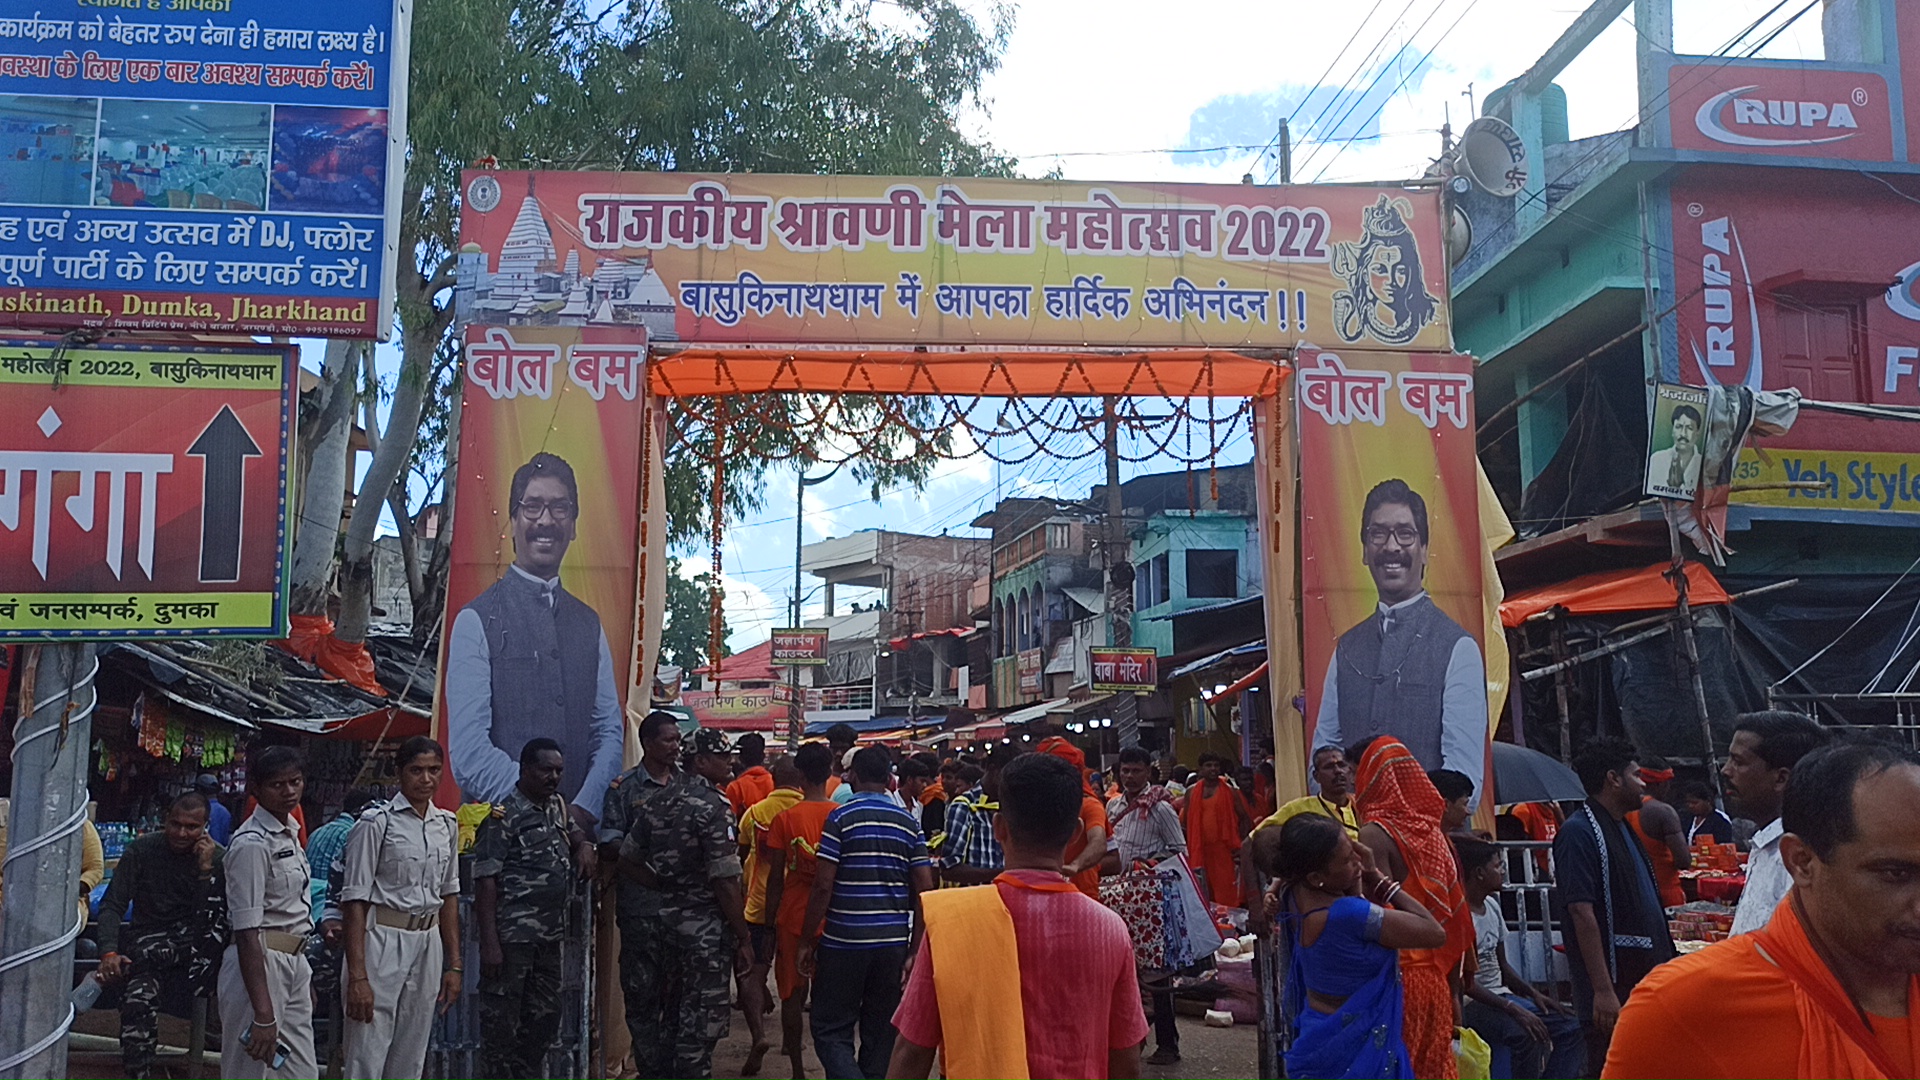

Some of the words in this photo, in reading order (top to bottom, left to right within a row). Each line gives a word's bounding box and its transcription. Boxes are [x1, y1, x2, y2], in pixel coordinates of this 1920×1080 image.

[0, 11, 74, 43] कार्यक्रम
[78, 15, 104, 42] को
[108, 15, 162, 45] बेहतर
[200, 19, 234, 47] देना
[238, 19, 260, 48] ही
[263, 29, 313, 50] हमारा
[317, 31, 359, 52] लक्ष्य
[0, 54, 53, 78] वस्था
[55, 50, 79, 79] के
[82, 50, 120, 82] लिए
[126, 59, 162, 82] एक
[165, 61, 199, 84] बार
[201, 63, 262, 87] अवश्य
[265, 59, 330, 89] सम्पर्क
[1732, 97, 1859, 129] RUPA
[26, 210, 71, 243] एवं
[74, 219, 138, 244] अन्य
[144, 220, 221, 246] उत्सव
[227, 216, 257, 248] में
[259, 222, 296, 252] DJ,
[303, 222, 374, 252] फ्लोर
[580, 183, 771, 248] राजकीय
[774, 186, 928, 250] श्रावणी
[939, 188, 1036, 253] मेला
[1043, 190, 1218, 256] महोत्सव
[1224, 207, 1331, 262] 2022
[52, 249, 110, 281] पार्टी
[115, 252, 147, 282] के
[154, 251, 209, 284] लिए
[215, 255, 305, 287] सम्पर्क
[122, 295, 221, 321] Dumka,
[227, 297, 367, 324] Jharkhand
[680, 271, 885, 326] बासुकिनाथधाम
[896, 274, 924, 318] में
[935, 284, 1033, 319] आपका
[1044, 276, 1131, 321] हार्दिक
[1701, 216, 1735, 366] RUPA
[80, 360, 141, 380] 2022,
[149, 357, 277, 383] बासुकिनाथधाम
[466, 329, 561, 399] बोल
[569, 344, 645, 399] बम
[1299, 354, 1391, 424] बोल
[1400, 372, 1473, 428] बम
[1782, 458, 1840, 500] Yeh
[29, 596, 143, 623] जनसम्पर्क,
[154, 602, 219, 624] दुमका
[1094, 661, 1117, 682] बाबा
[1118, 655, 1143, 682] मंदिर
